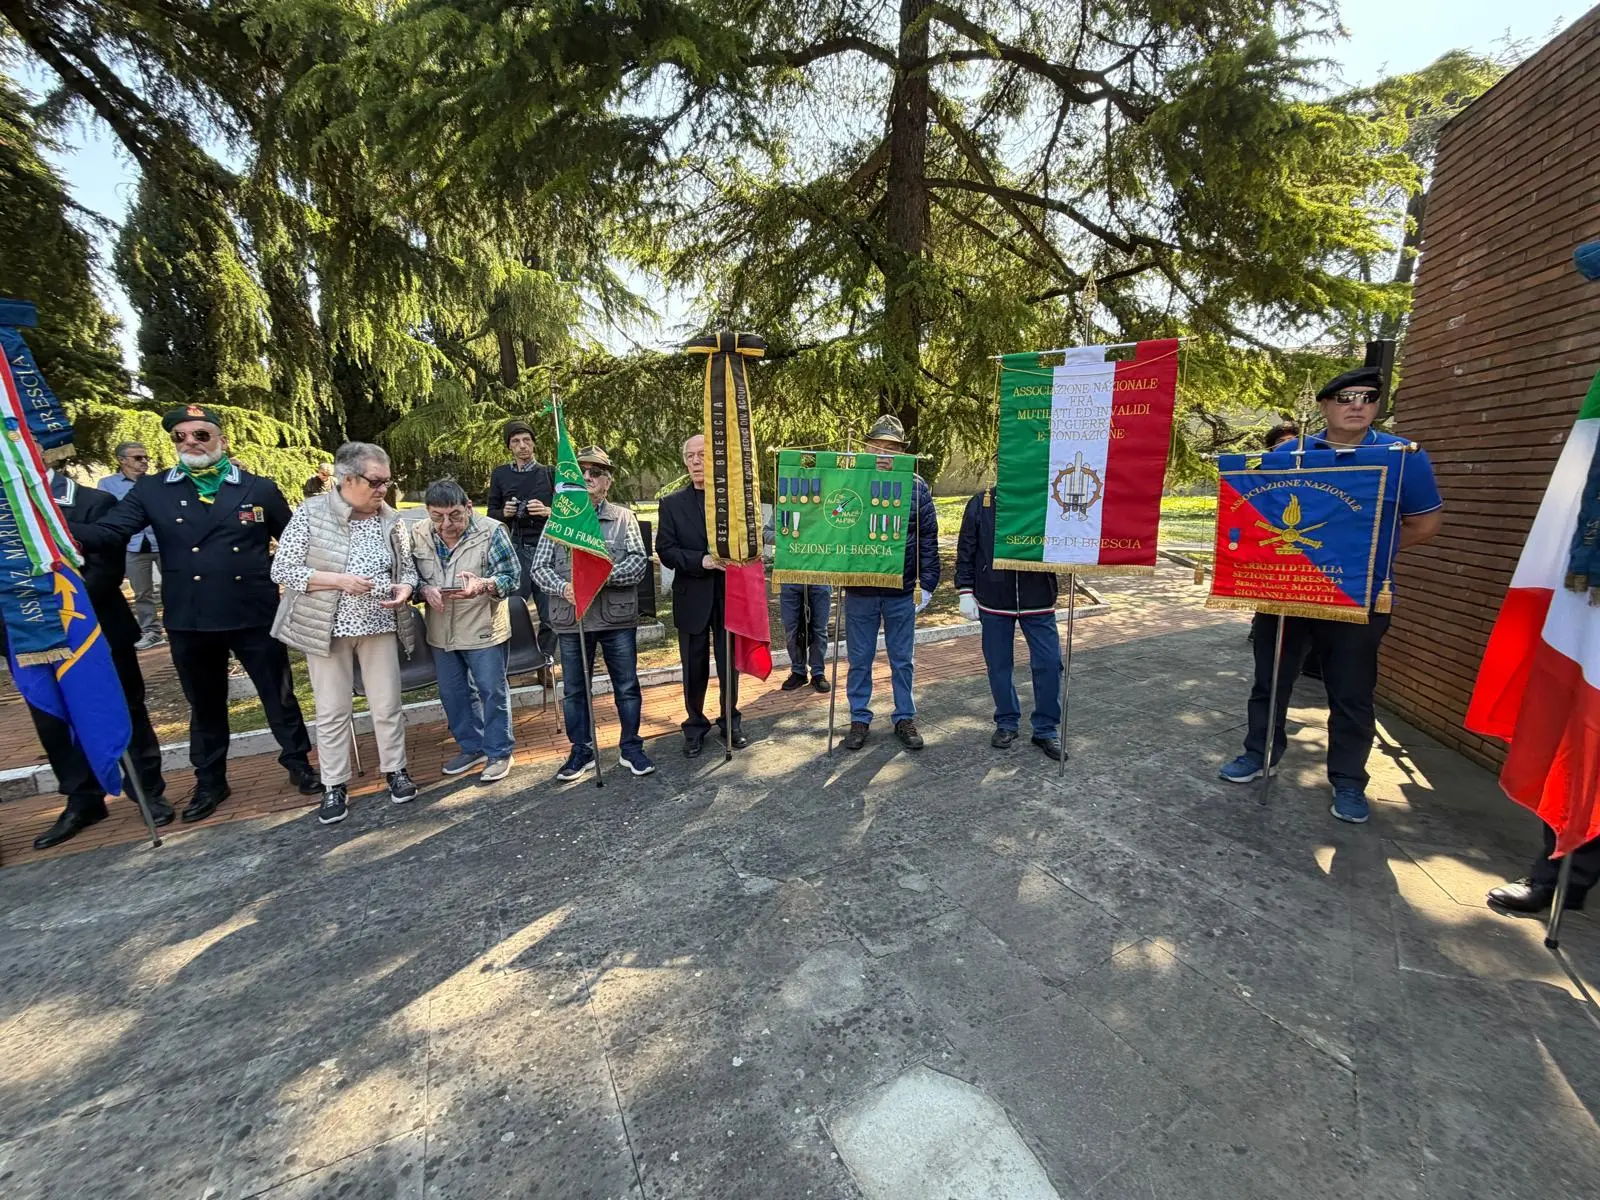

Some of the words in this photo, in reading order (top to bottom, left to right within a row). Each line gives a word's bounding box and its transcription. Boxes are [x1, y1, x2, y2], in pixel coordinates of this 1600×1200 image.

[11, 355, 64, 432] BRESCIA
[1012, 383, 1090, 397] ASSOCIAZIONE
[1093, 377, 1159, 394] NAZIONALE
[1069, 395, 1094, 407] FRA
[1017, 408, 1072, 420] MUTILATI
[1075, 407, 1092, 418] ED
[1095, 403, 1151, 417] INVALIDI
[1048, 419, 1061, 430] DI
[1064, 418, 1115, 430] GUERRA
[713, 401, 725, 466] BRESCIA
[1036, 431, 1046, 442] E
[1051, 428, 1125, 442] FONDAZIONE
[743, 456, 753, 480] CADUTI
[717, 474, 727, 513] PROV.
[1230, 479, 1301, 513] ASSOCIAZIONE
[1303, 479, 1363, 513] NAZIONALE
[563, 526, 575, 538] DI
[575, 530, 606, 549] FIUMICE
[718, 519, 727, 542] SEZ.
[789, 543, 833, 555] SEZIONE
[836, 544, 847, 555] DI
[851, 544, 893, 557] BRESCIA
[1006, 535, 1060, 546] SEZIONE
[1064, 537, 1077, 547] DI
[1080, 538, 1141, 549] BRESCIA
[1233, 562, 1287, 572] CARRISTI
[1288, 563, 1344, 574] D'ITALIA
[1232, 571, 1276, 581] SEZIONE
[1278, 573, 1290, 582] DI
[1292, 574, 1343, 585] BRESCIA
[1234, 589, 1284, 600] GIOVANNI
[1284, 592, 1334, 603] SAROTTI
